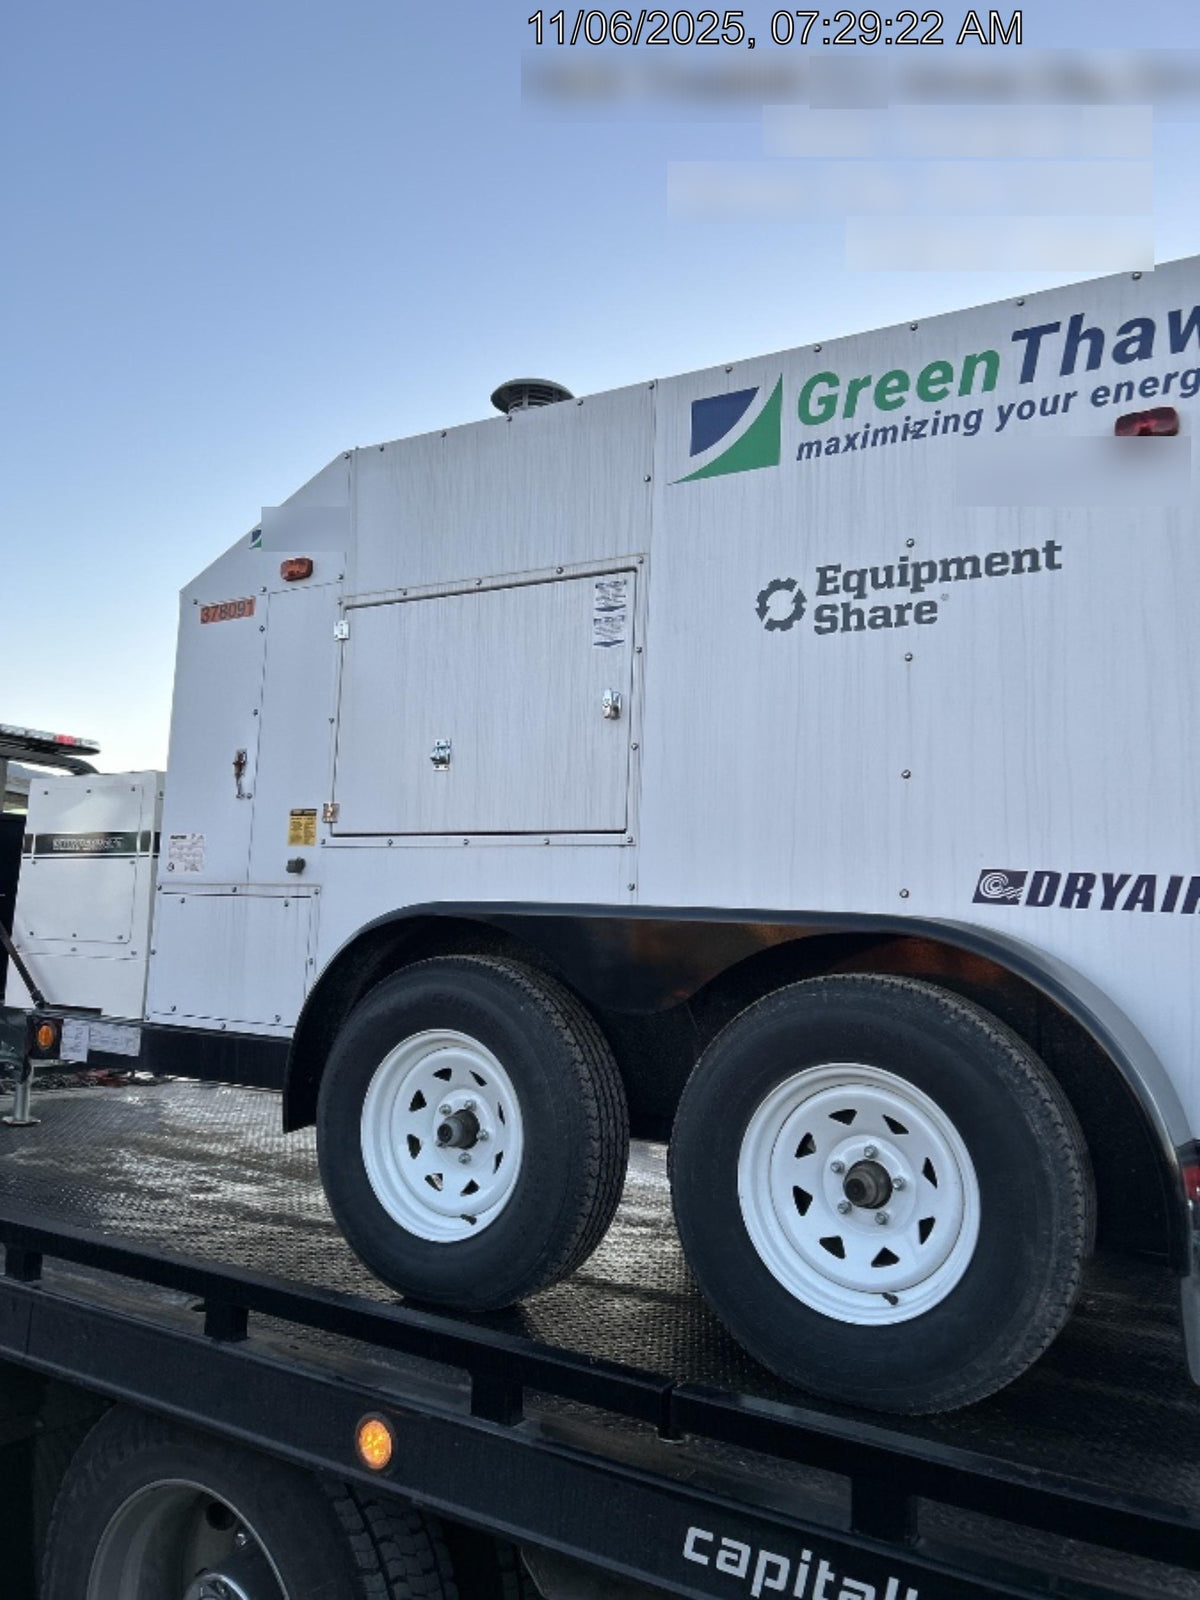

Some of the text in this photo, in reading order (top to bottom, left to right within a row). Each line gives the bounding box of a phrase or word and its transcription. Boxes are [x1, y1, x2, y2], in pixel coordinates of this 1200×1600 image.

[796, 408, 984, 461] maximizing
[995, 390, 1078, 432] your
[815, 539, 1063, 600] Equipment
[813, 600, 938, 636] Share
[683, 1526, 919, 1600] capita
